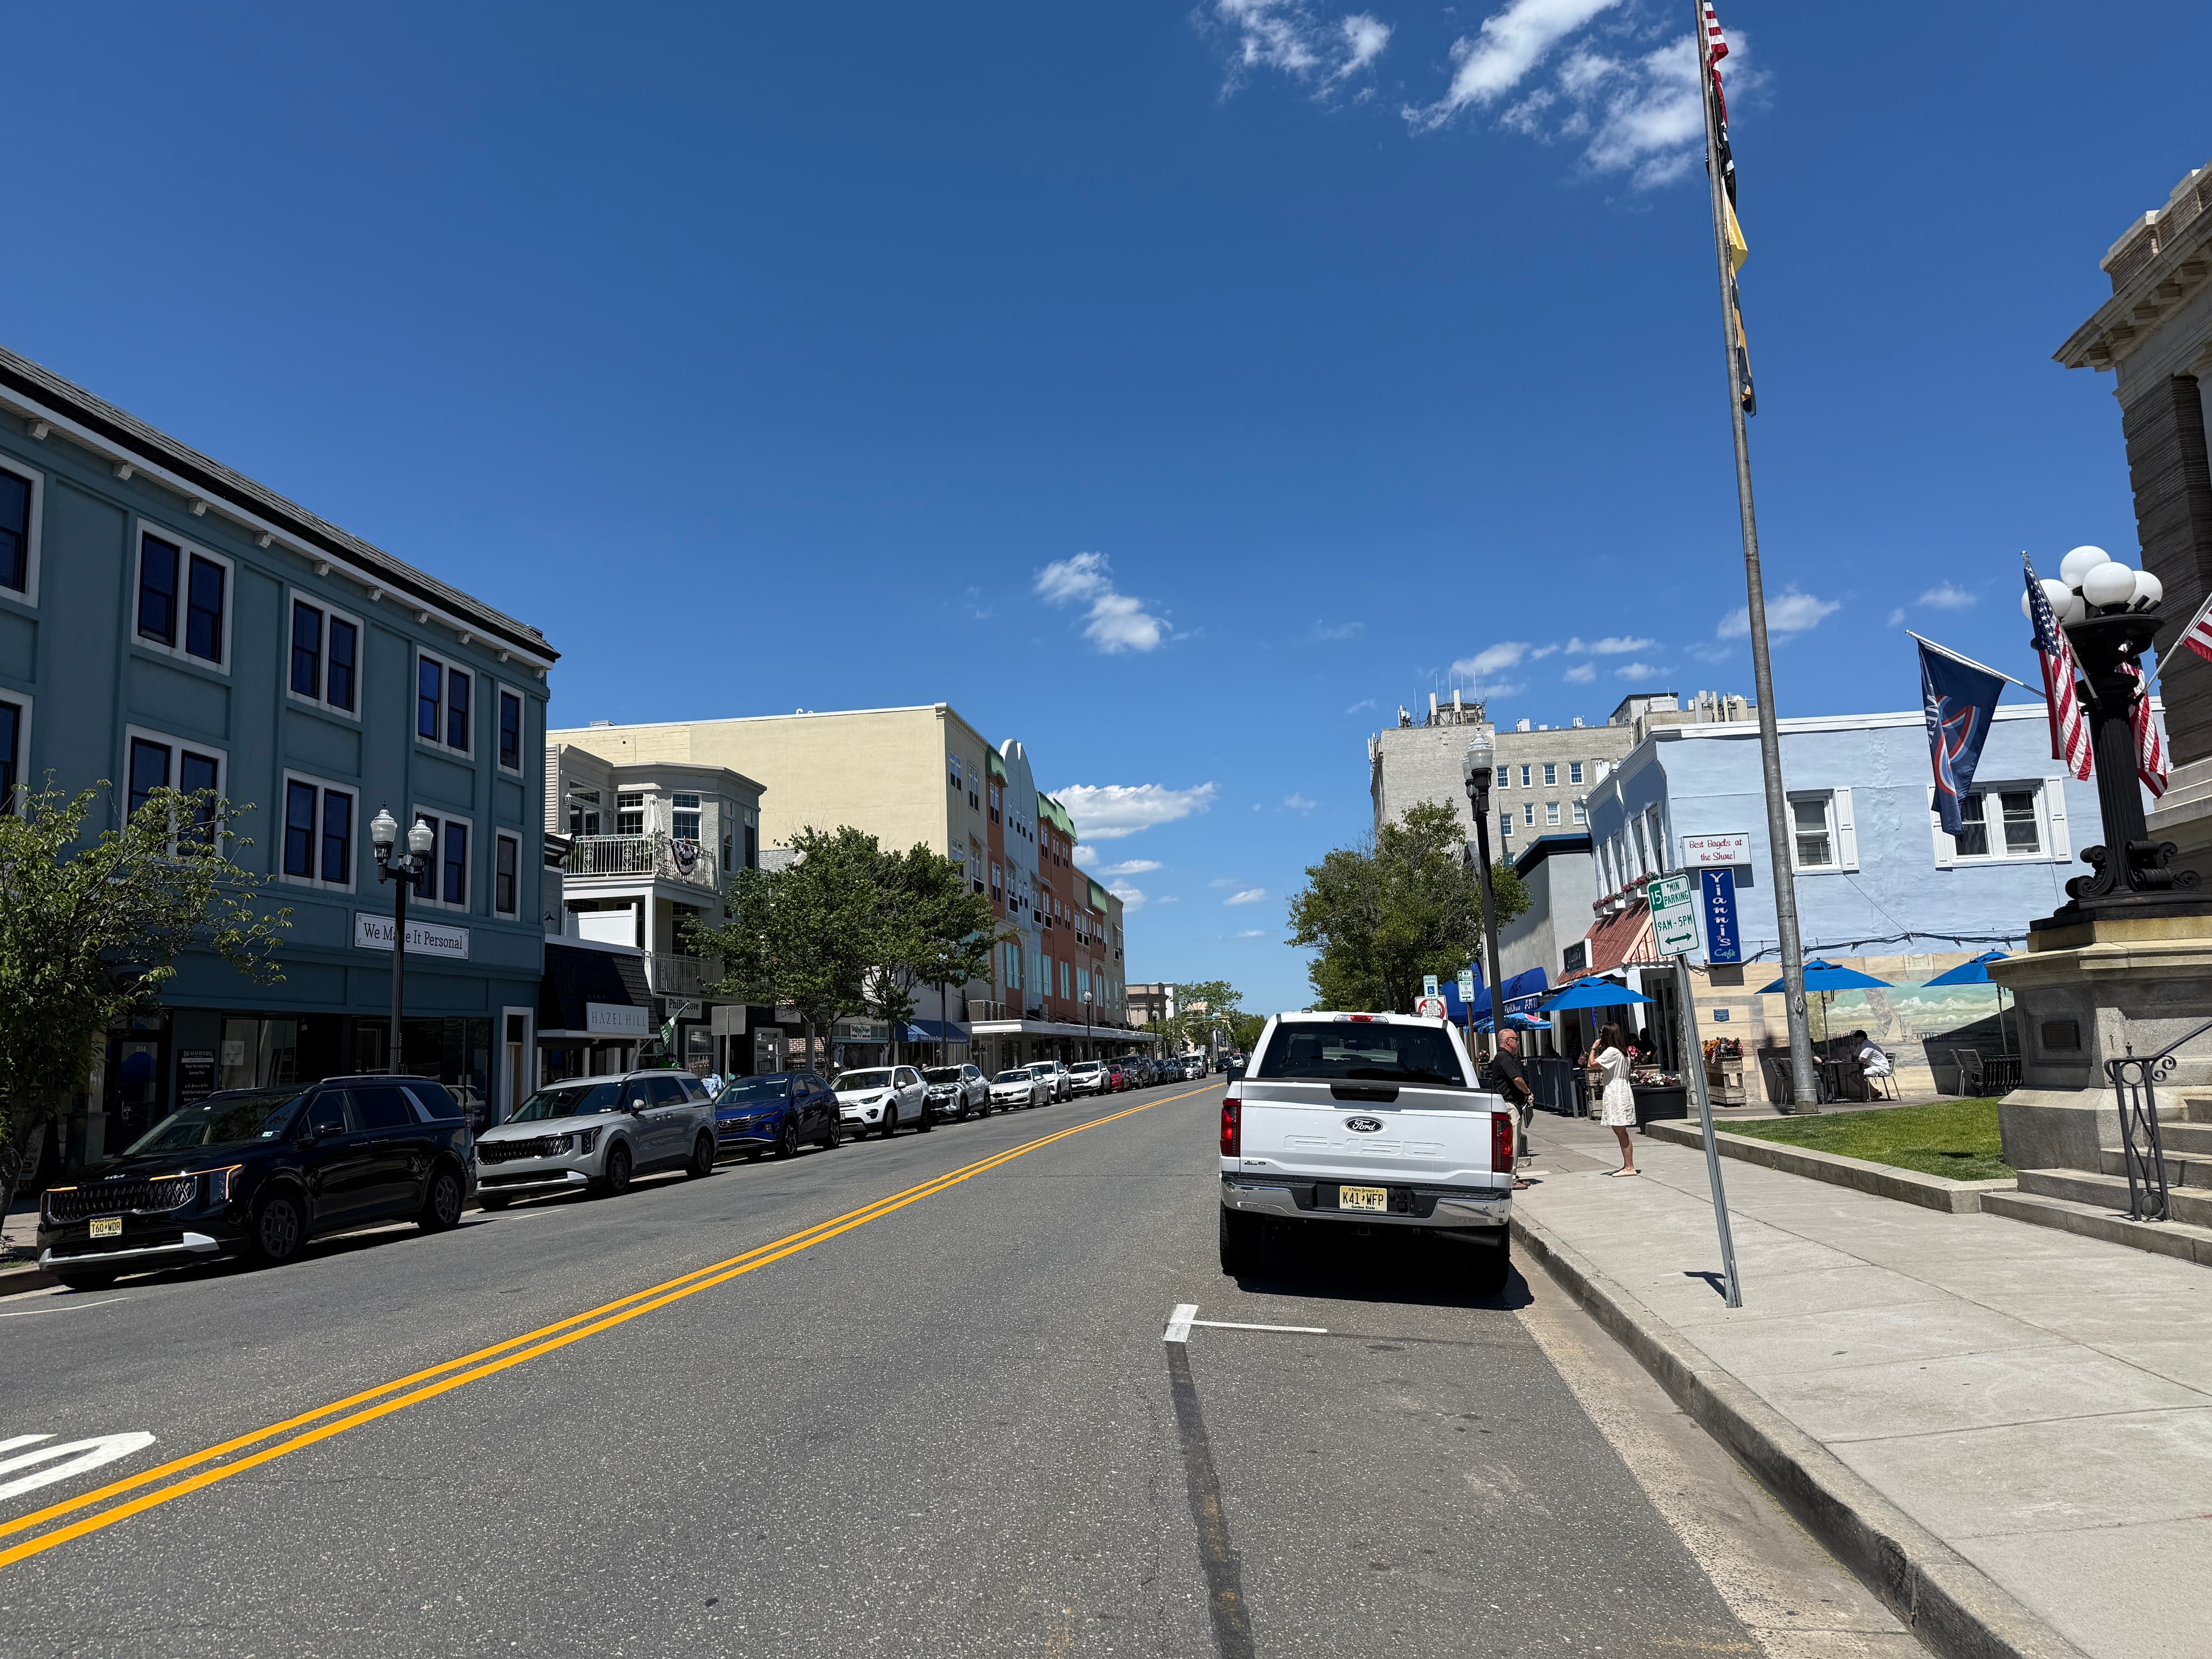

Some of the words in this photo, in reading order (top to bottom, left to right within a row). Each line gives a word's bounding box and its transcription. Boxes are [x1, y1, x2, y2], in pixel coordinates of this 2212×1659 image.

[1689, 840, 1704, 849] Best
[1707, 838, 1731, 850] Bagels
[1700, 853, 1711, 861] the
[1713, 850, 1736, 861] Shore!
[1669, 881, 1680, 892] MIN
[1650, 890, 1662, 905] 15
[1664, 891, 1689, 905] PARKING
[1657, 919, 1673, 931] 9AM
[1678, 914, 1693, 927] 5PM
[363, 922, 380, 939] We
[382, 925, 411, 943] Me
[413, 930, 421, 945] It
[424, 931, 463, 949] Personal
[592, 1011, 623, 1025] HAZEL
[626, 1013, 646, 1027] HILL
[1352, 1119, 1376, 1131] Ford
[1284, 1134, 1446, 1159] F-150
